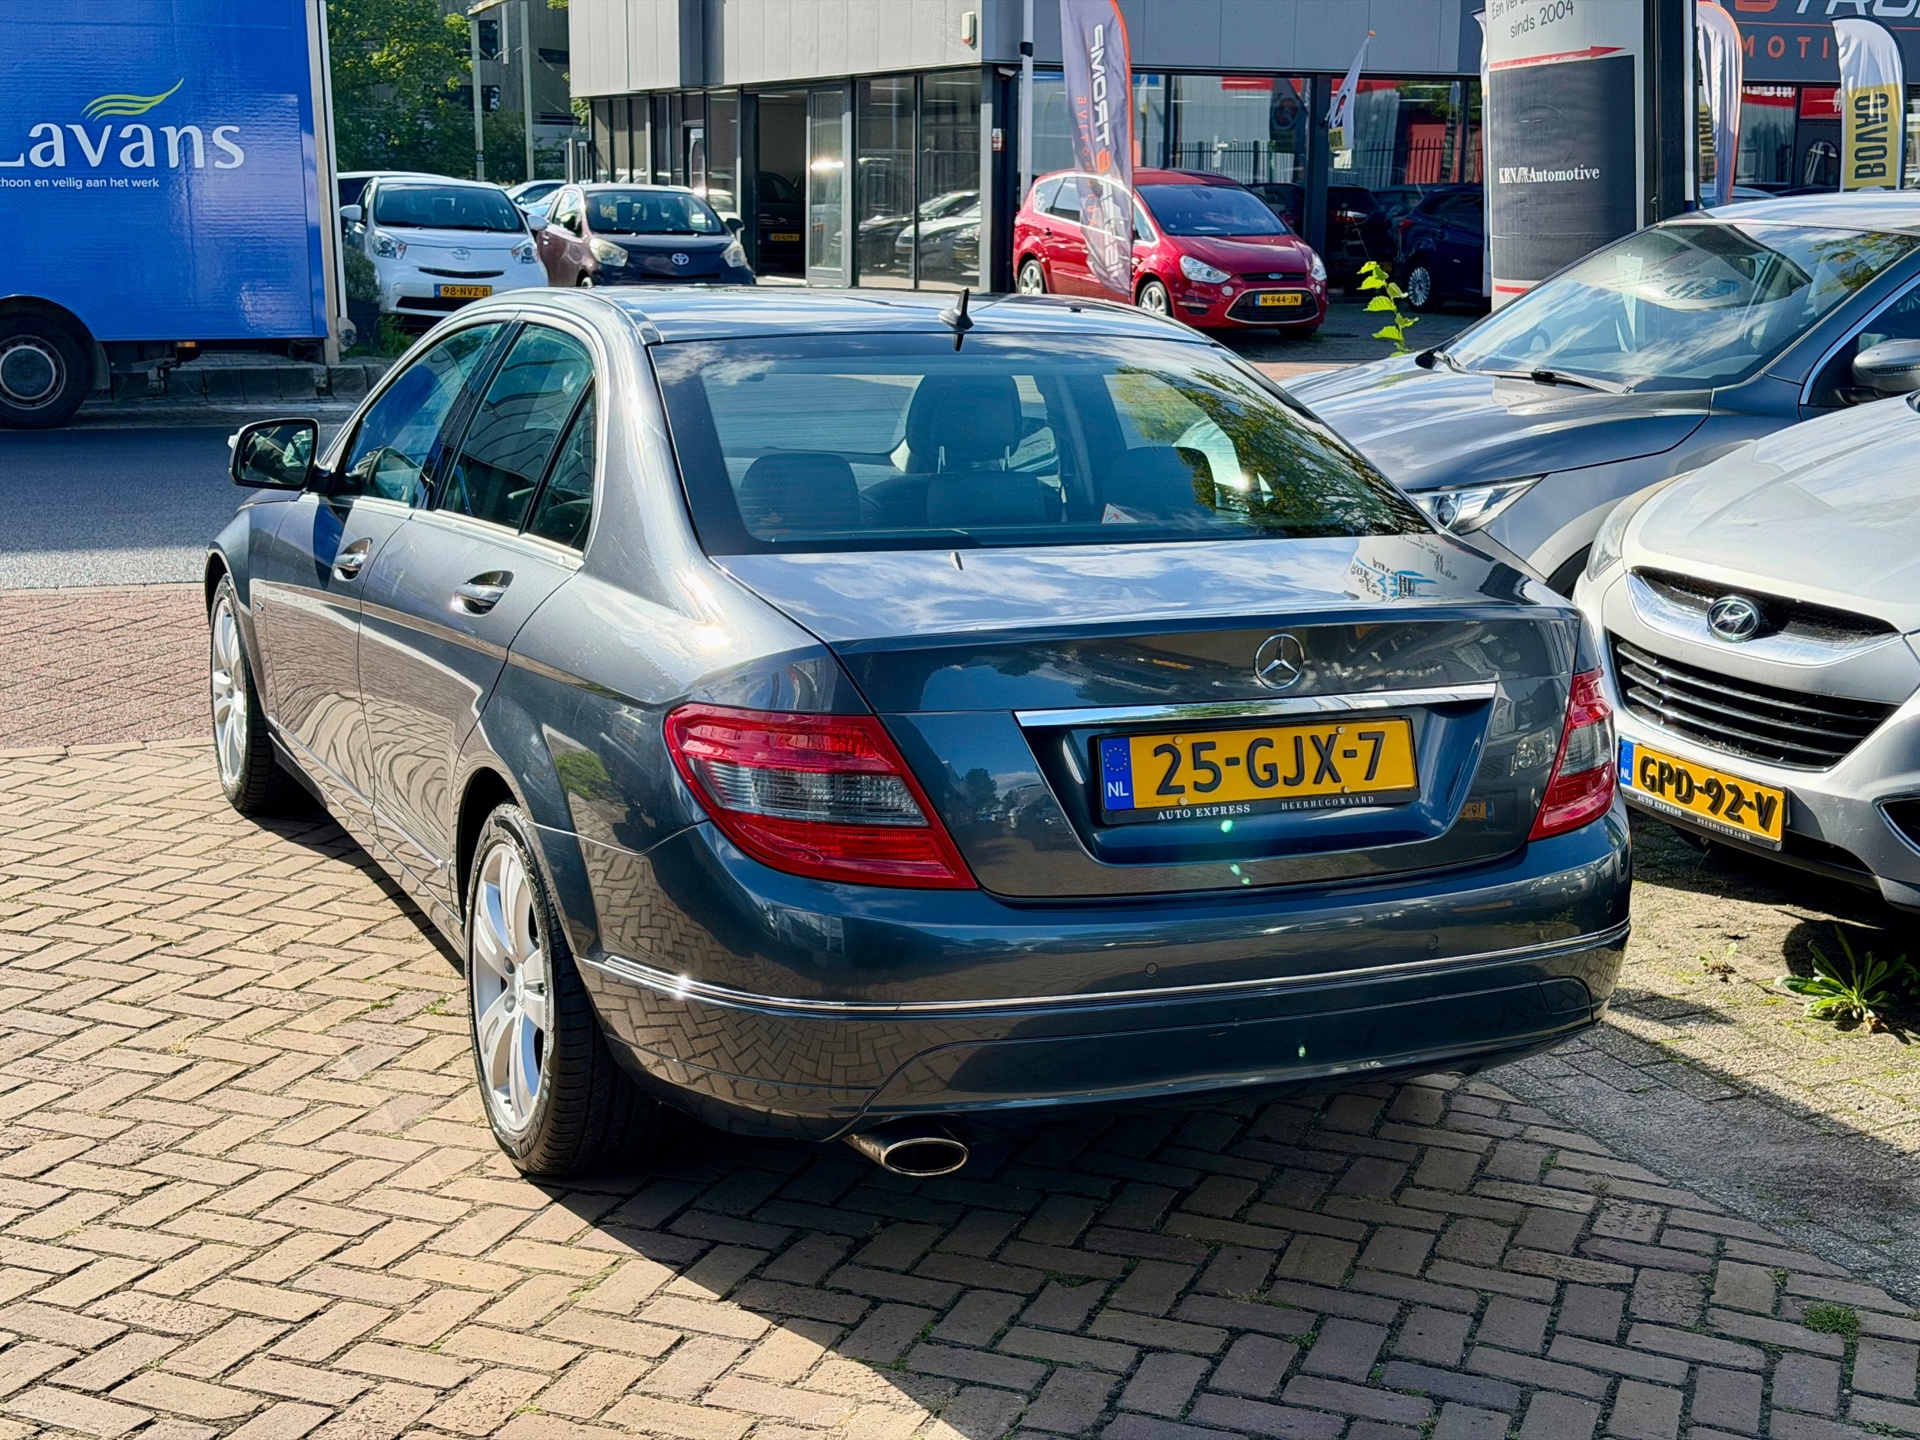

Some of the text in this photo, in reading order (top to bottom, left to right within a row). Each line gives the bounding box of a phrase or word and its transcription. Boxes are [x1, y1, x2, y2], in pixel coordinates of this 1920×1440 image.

[1510, 0, 1574, 38] sinds 2004
[0, 177, 160, 190] hoon en veilig aan het werk
[1529, 164, 1600, 183] Automotive
[1153, 730, 1386, 796] 25-GJX-7
[1620, 767, 1632, 781] NL
[1107, 781, 1130, 798] NL
[1640, 755, 1779, 833] GPD-92-V
[1157, 795, 1375, 820] AUTO EXPRESS HEERHUGOWAARD
